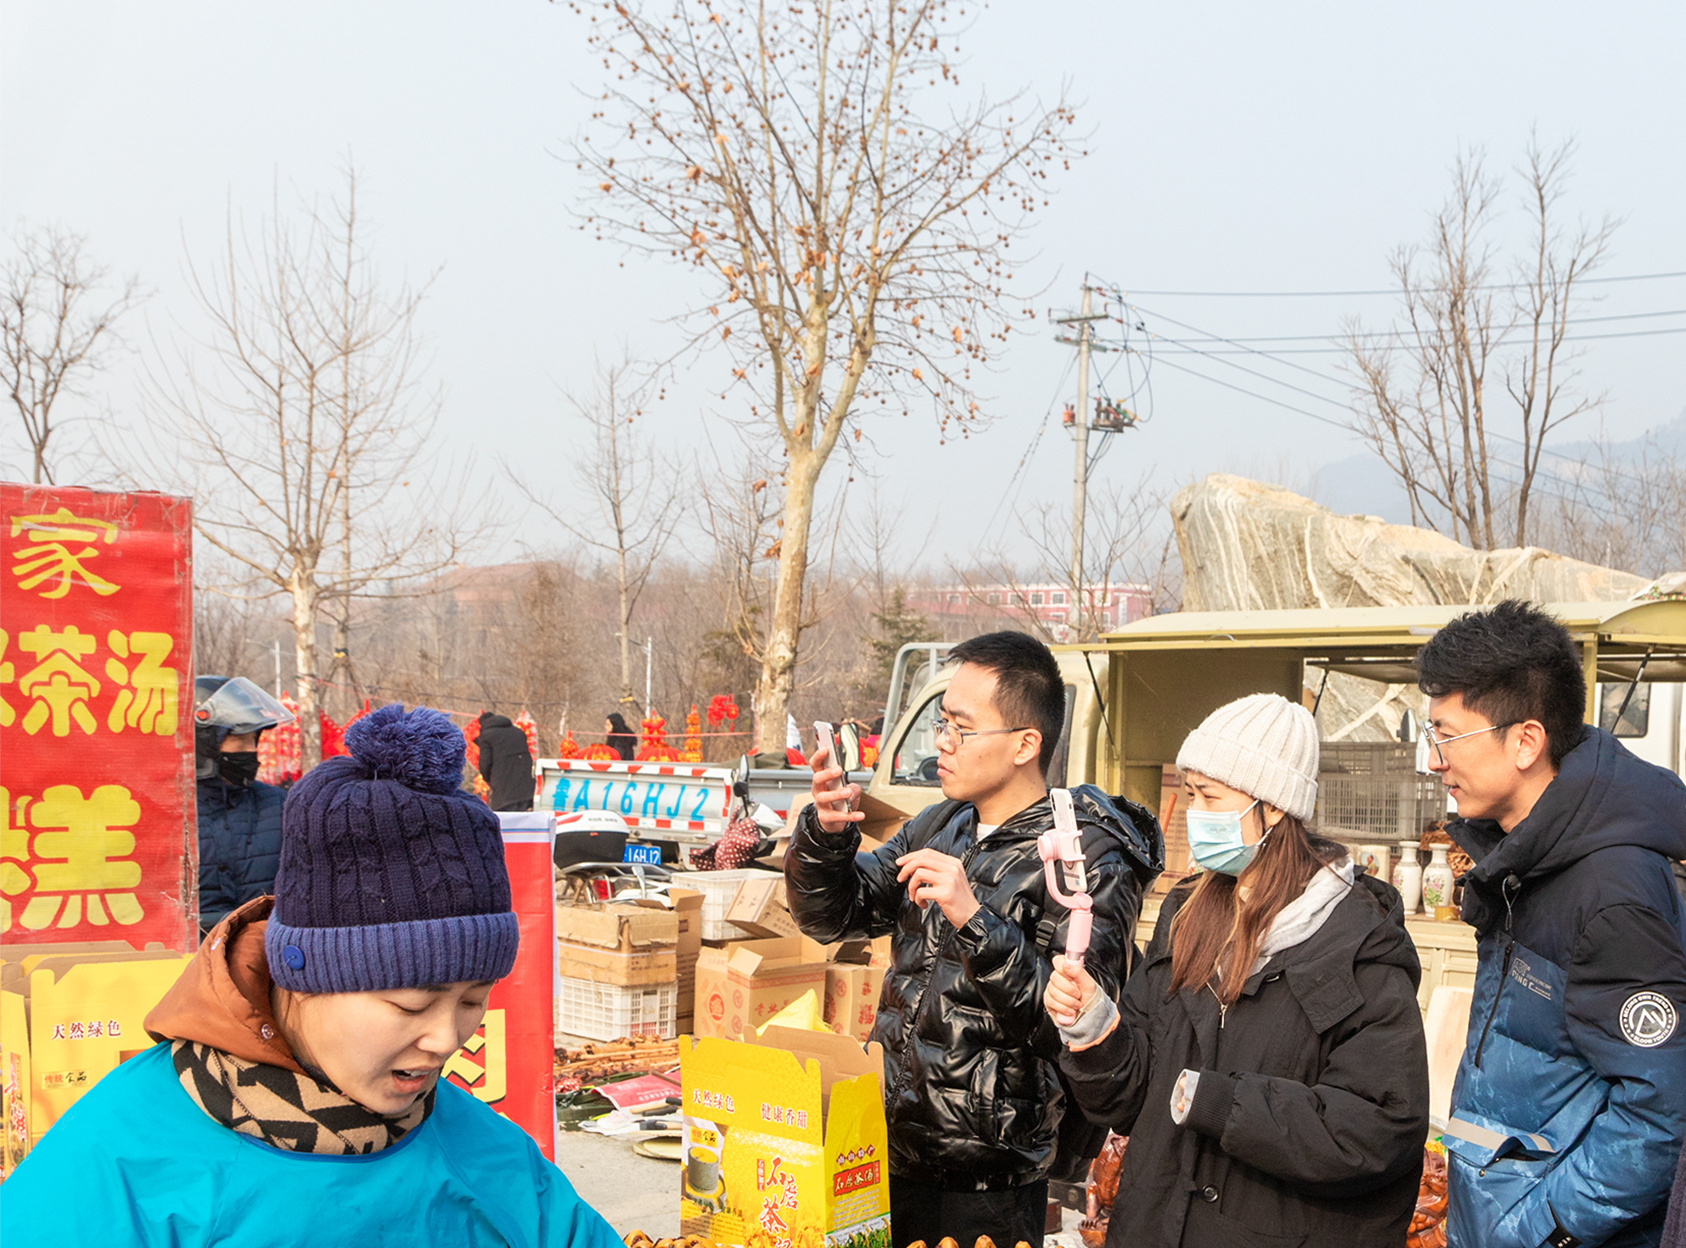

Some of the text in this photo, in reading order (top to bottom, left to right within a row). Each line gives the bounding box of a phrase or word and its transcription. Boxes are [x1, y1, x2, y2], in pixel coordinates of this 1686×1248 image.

[10, 507, 121, 599] 家
[51, 1019, 122, 1041] 天然绿色
[693, 1089, 735, 1114] 天然绿色
[761, 1102, 807, 1129] 健康香甜
